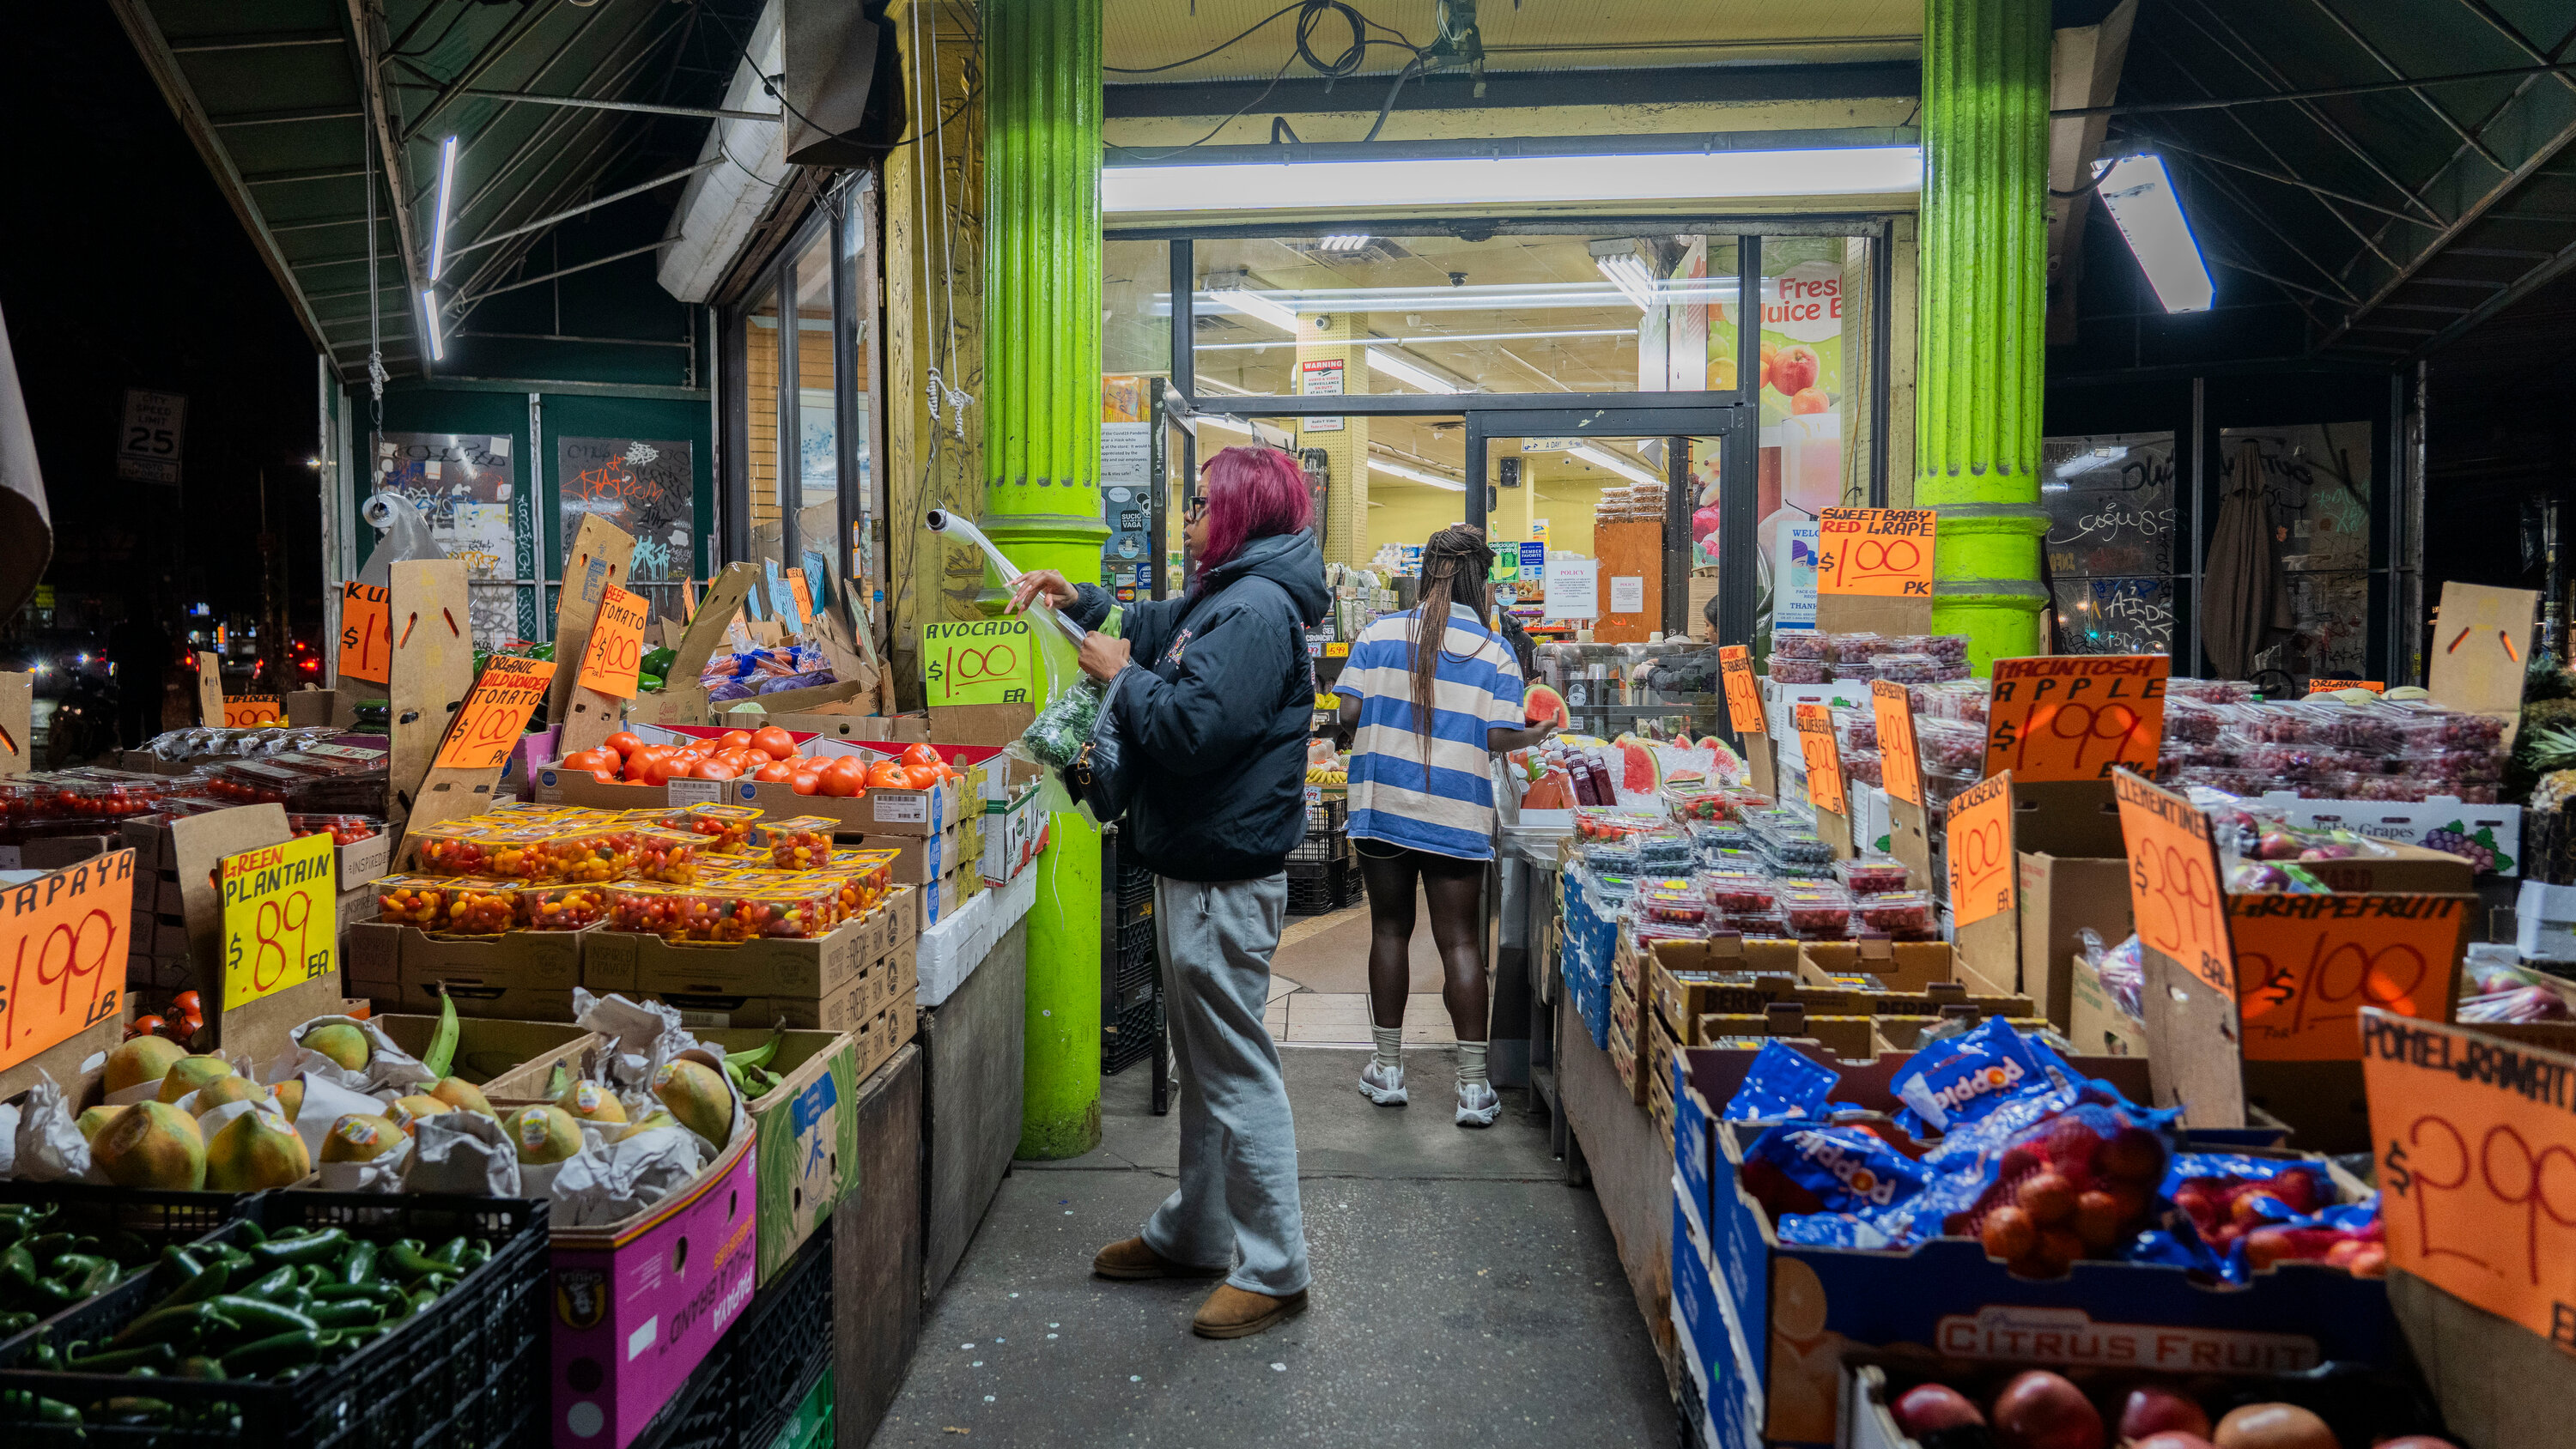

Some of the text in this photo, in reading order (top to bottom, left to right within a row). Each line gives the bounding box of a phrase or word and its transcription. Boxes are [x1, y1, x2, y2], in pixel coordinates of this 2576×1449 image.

[1779, 274, 1842, 300] Fres
[1830, 298, 1842, 319] B
[1304, 361, 1342, 370] WARNING
[137, 403, 172, 416] SPEED
[138, 415, 166, 425] LIMIT
[128, 427, 173, 453] 25
[1821, 507, 1932, 523] SWEET BABY
[1821, 520, 1934, 537] RED GRAPE
[606, 585, 628, 603] BEEF
[1903, 581, 1930, 595] PK
[601, 602, 645, 631] TOMATO
[927, 621, 1029, 639] AVOCADO
[478, 671, 551, 692] WILD WONDER
[927, 645, 1017, 698] $1.00
[1995, 659, 2155, 681] MACINTOSH
[223, 694, 279, 703] LIFLOWER
[473, 688, 541, 706] TOMATO
[1003, 688, 1026, 703] EA
[1994, 677, 2166, 702] APPLE
[1991, 702, 2142, 771] $1.99
[489, 749, 510, 765] PK
[1947, 774, 2008, 823] BLACKBERRY
[2117, 774, 2208, 840] CLEMENTINE
[2359, 822, 2415, 839] Grapes
[223, 846, 284, 880] GREEN
[351, 853, 386, 875] INSPIRED
[0, 850, 135, 918] APAYA
[226, 852, 331, 908] PLANTAIN
[2233, 894, 2458, 919] GRAPEFRUIT
[307, 949, 329, 979] EA
[589, 944, 634, 961] INSPIRED
[849, 931, 867, 973] FRESH
[84, 989, 117, 1028] LB
[849, 984, 867, 1025] FRESH
[1704, 988, 1777, 1014] BERRY
[2363, 1014, 2576, 1113] POMEGRANAT
[670, 1275, 720, 1345] BRAND
[713, 1265, 754, 1332] PAPAYA
[1945, 1322, 2312, 1371] CITRUS FRUIT
